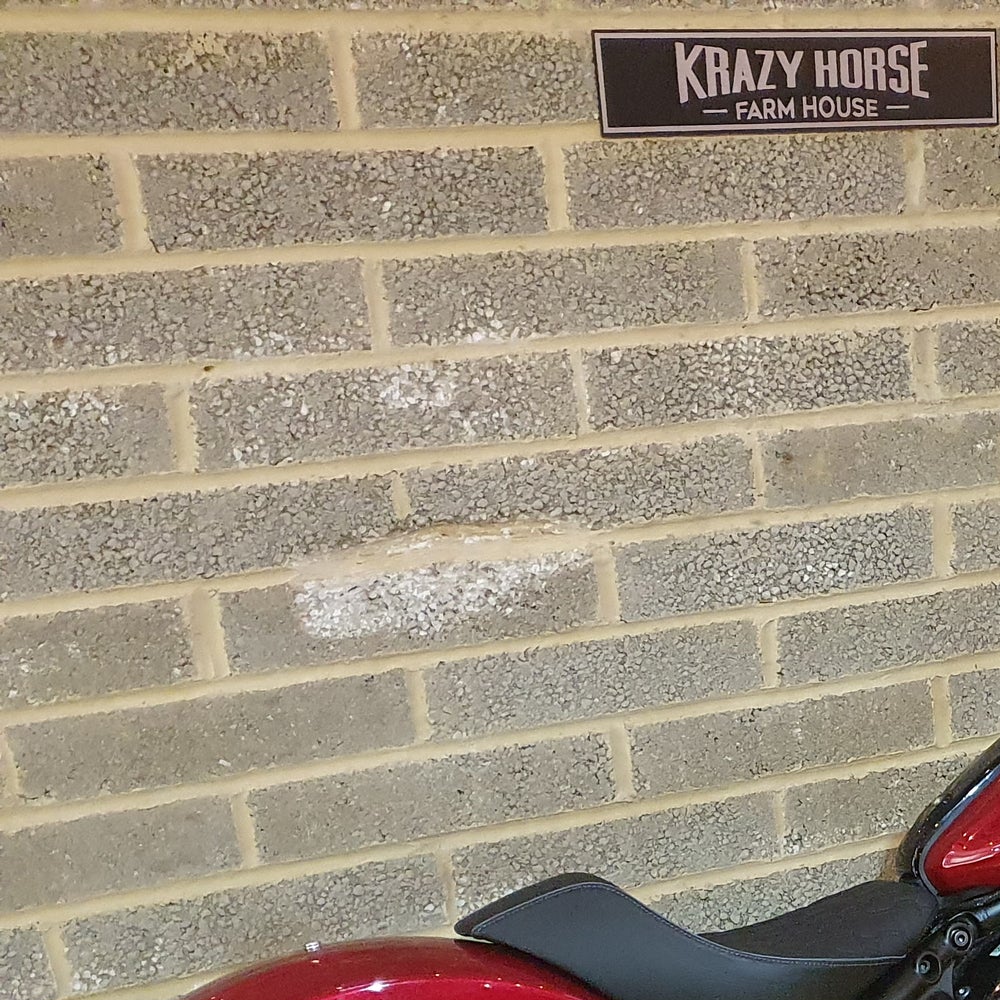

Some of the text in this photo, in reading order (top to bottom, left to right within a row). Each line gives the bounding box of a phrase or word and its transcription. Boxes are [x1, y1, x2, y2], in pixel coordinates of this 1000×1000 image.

[674, 40, 930, 104] KRAZY HORSE
[735, 95, 879, 120] FARM HOUSE
